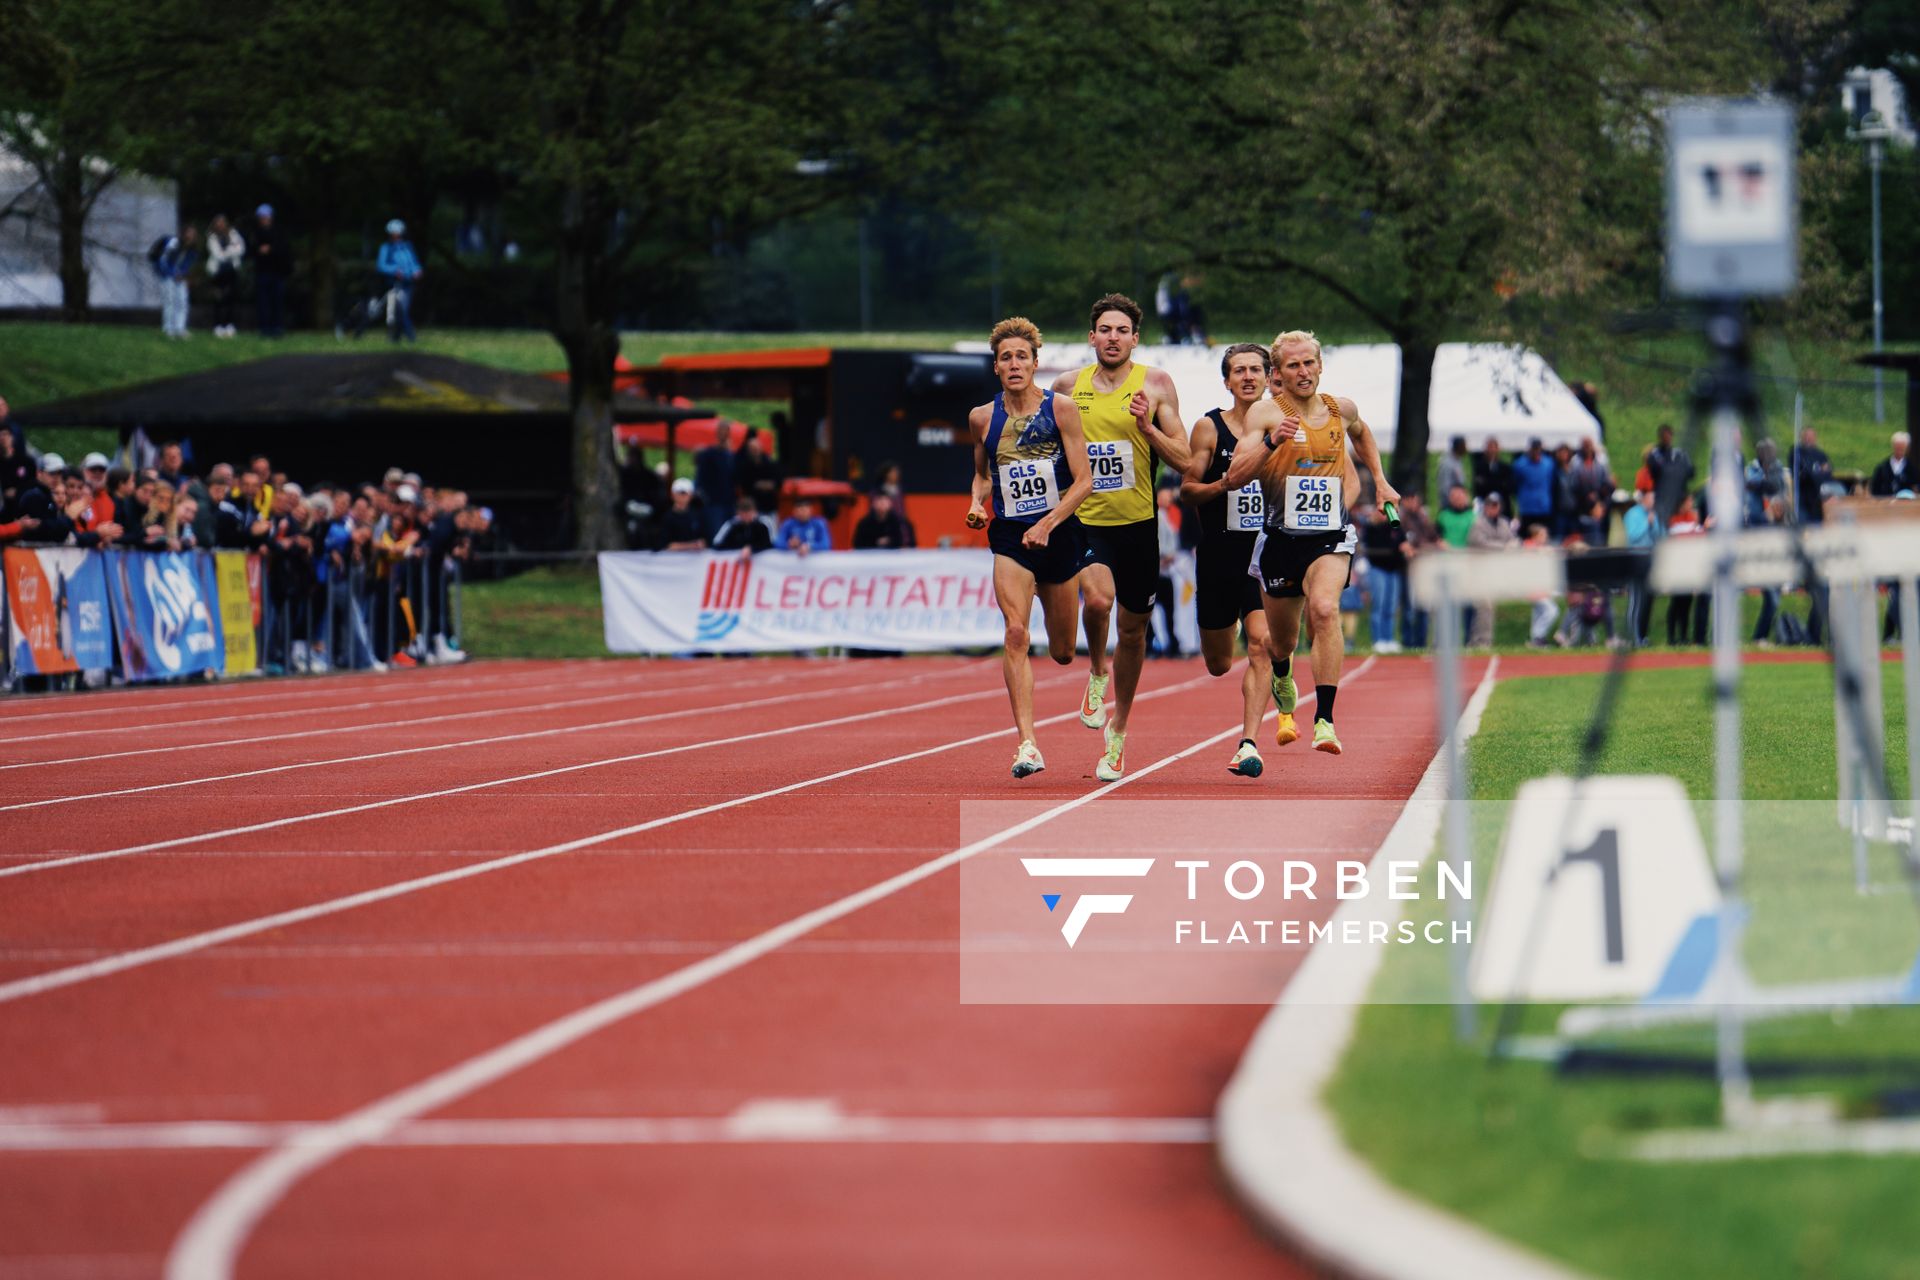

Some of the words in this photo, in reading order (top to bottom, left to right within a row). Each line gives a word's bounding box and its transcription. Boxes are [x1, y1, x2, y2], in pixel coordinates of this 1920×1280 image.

[1088, 444, 1116, 456] GLS
[1009, 464, 1037, 479] GLS
[1089, 457, 1124, 476] 705
[1009, 477, 1047, 499] 349
[1299, 479, 1328, 491] GLS
[1027, 499, 1046, 507] PLAN
[1295, 492, 1332, 512] 248
[1269, 577, 1286, 586] LSC
[754, 575, 1000, 609] LEICHTATHL
[1548, 829, 1624, 963] 1
